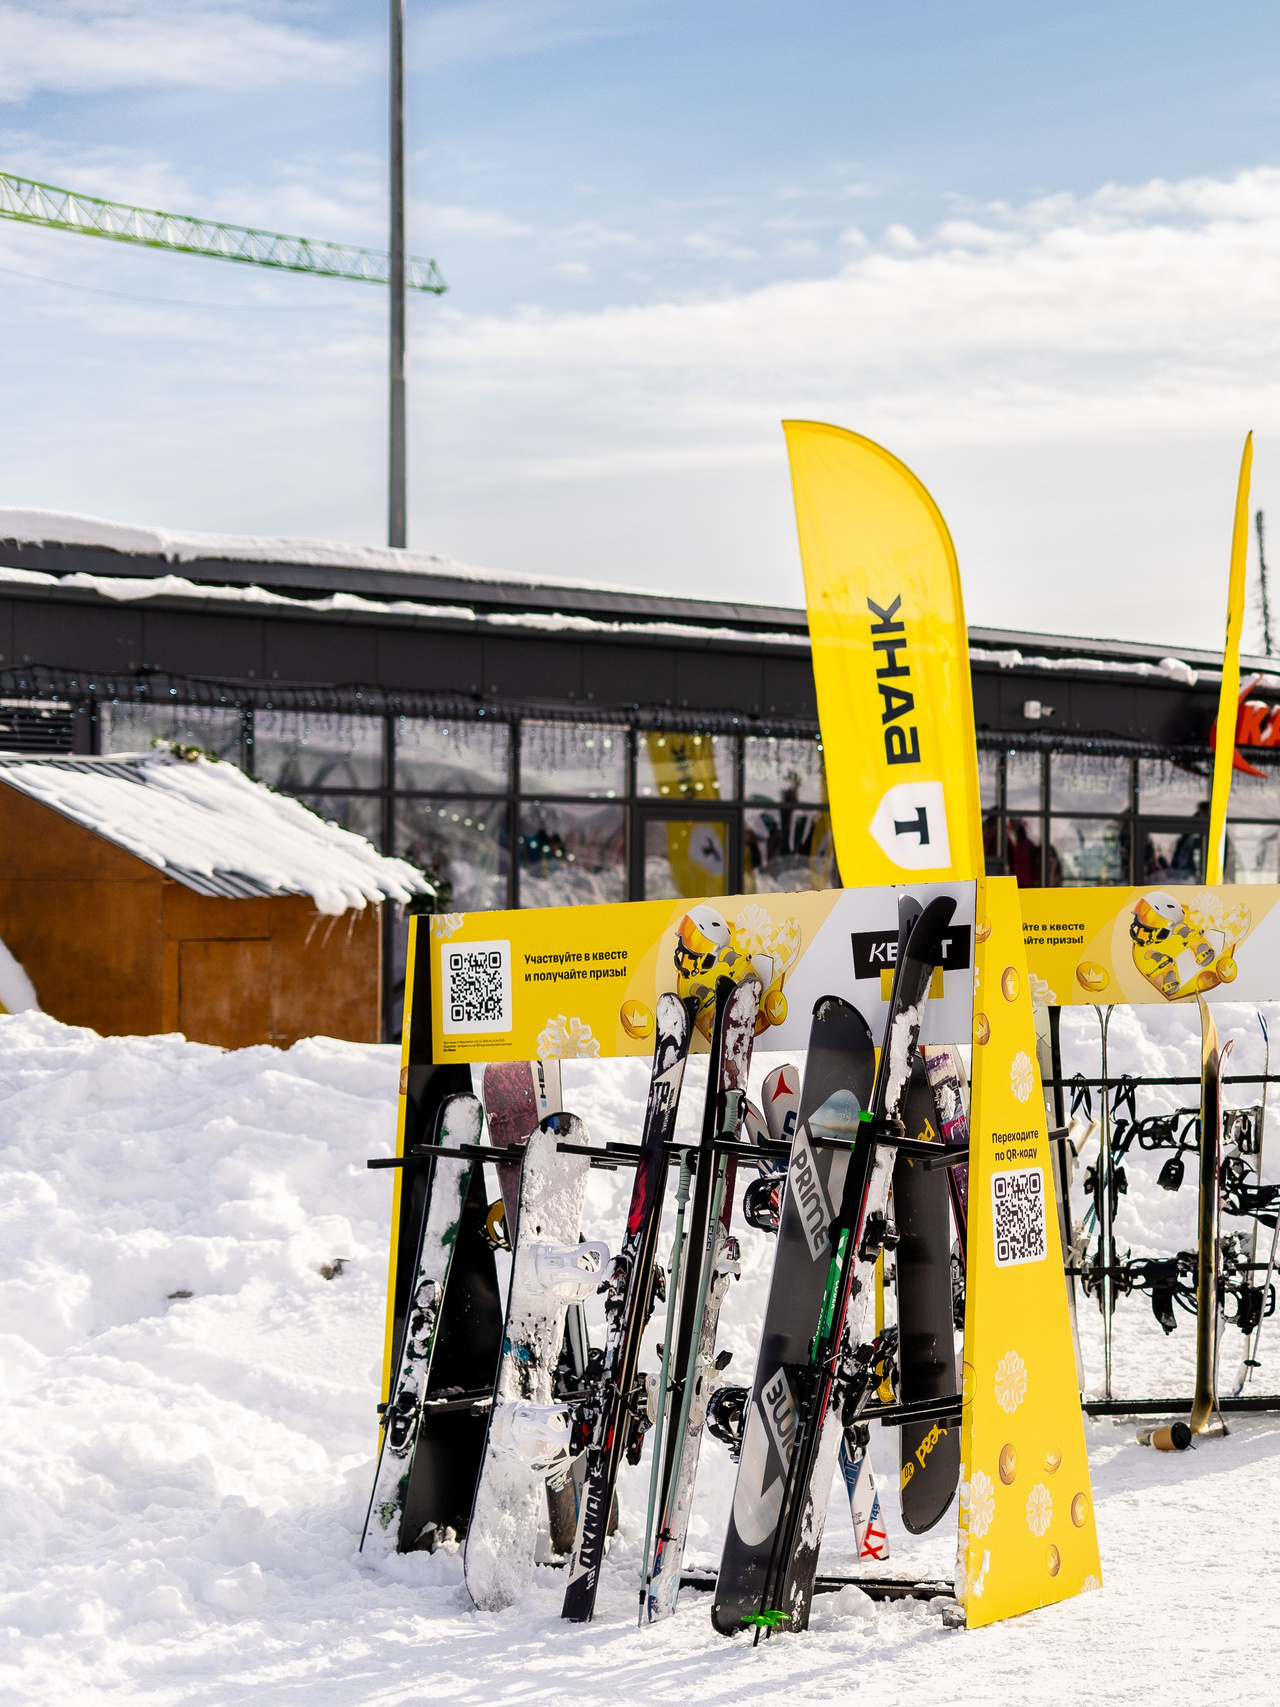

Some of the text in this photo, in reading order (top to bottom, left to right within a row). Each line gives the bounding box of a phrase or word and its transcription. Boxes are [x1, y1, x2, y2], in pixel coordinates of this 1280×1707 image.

[1049, 923, 1085, 931] квесте
[1046, 935, 1084, 946] призы!
[524, 950, 628, 965] Участвуйте в квесте
[524, 966, 627, 983] и получайте призы!
[992, 1130, 1039, 1145] Переходите
[995, 1148, 1038, 1162] по QR-коду
[791, 1148, 829, 1252] PRIME
[870, 1503, 881, 1522] 149
[860, 1522, 887, 1561] XT
